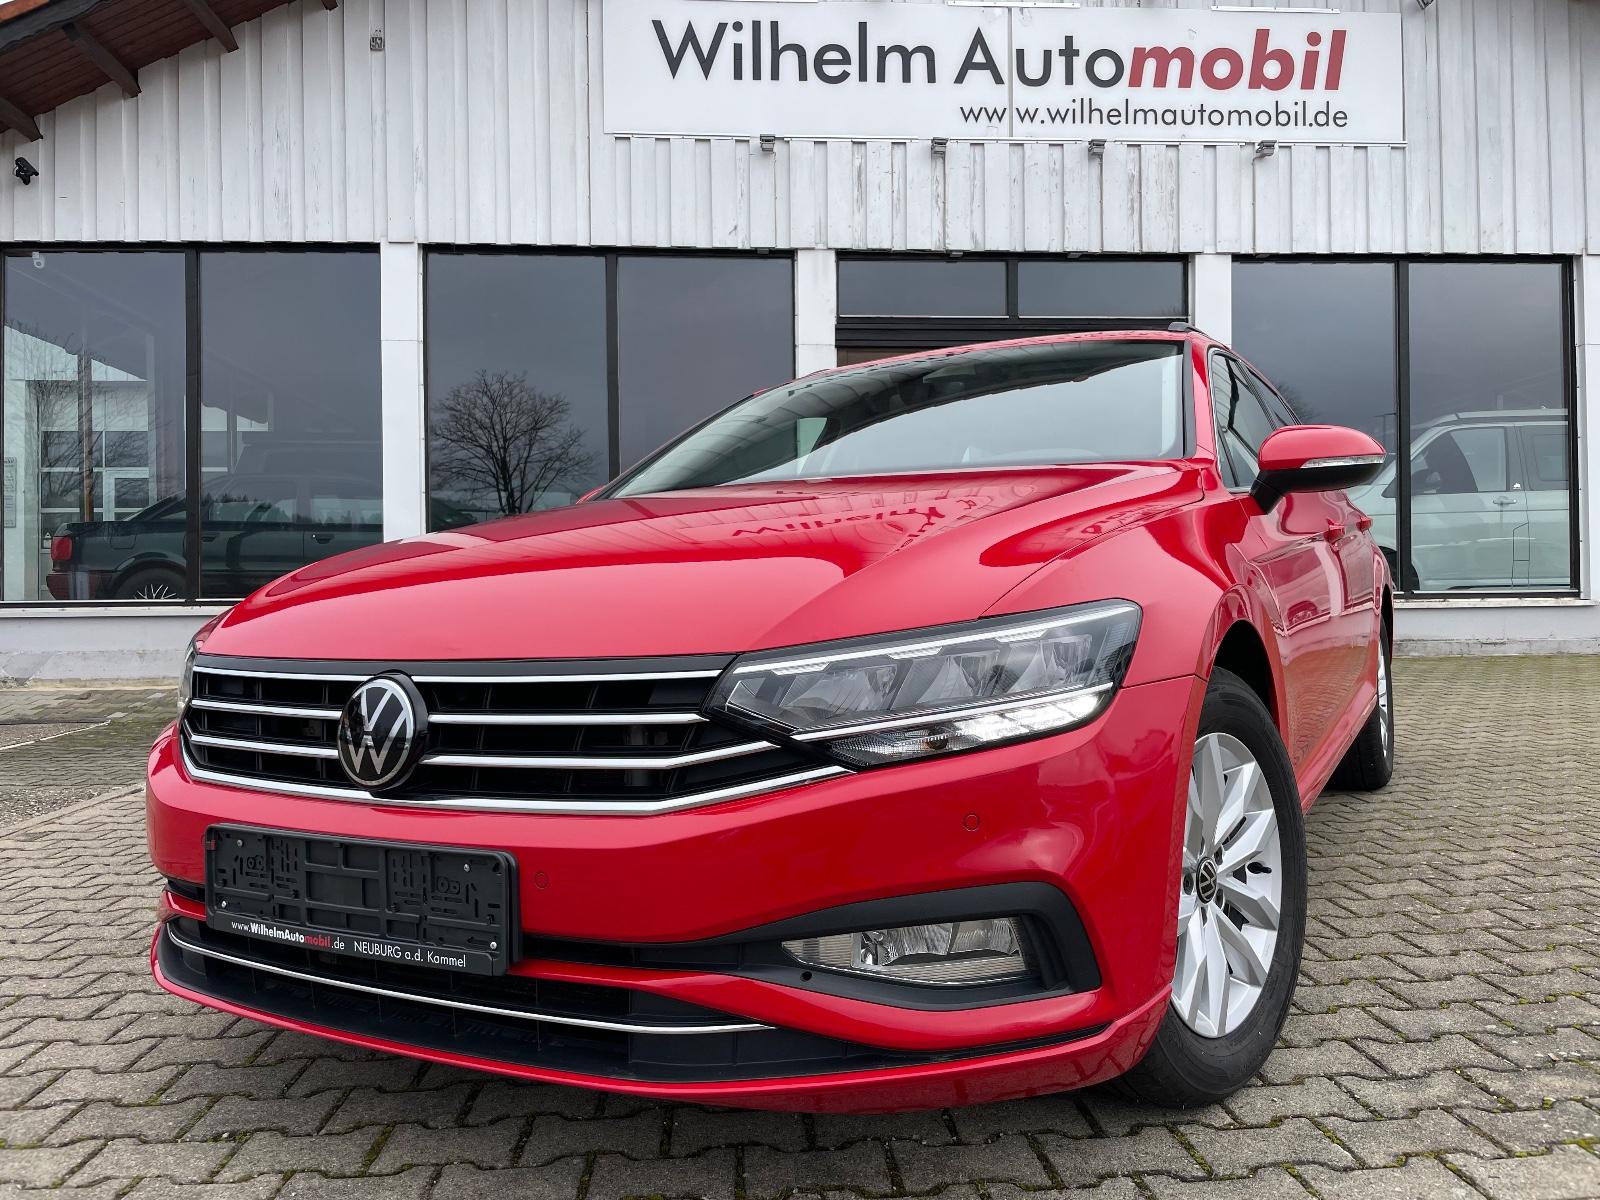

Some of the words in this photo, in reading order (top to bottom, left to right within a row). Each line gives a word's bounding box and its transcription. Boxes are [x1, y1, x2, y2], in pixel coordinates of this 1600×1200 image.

[652, 20, 936, 84] Wilhelm
[954, 27, 1346, 91] Automobil
[960, 98, 1348, 128] www.wilhelmautomobil.de
[231, 921, 345, 950] www.WilhelmAutomobil.de
[354, 941, 402, 959] NEUBURG
[404, 950, 424, 963] a.d.
[427, 953, 466, 968] Kammel
